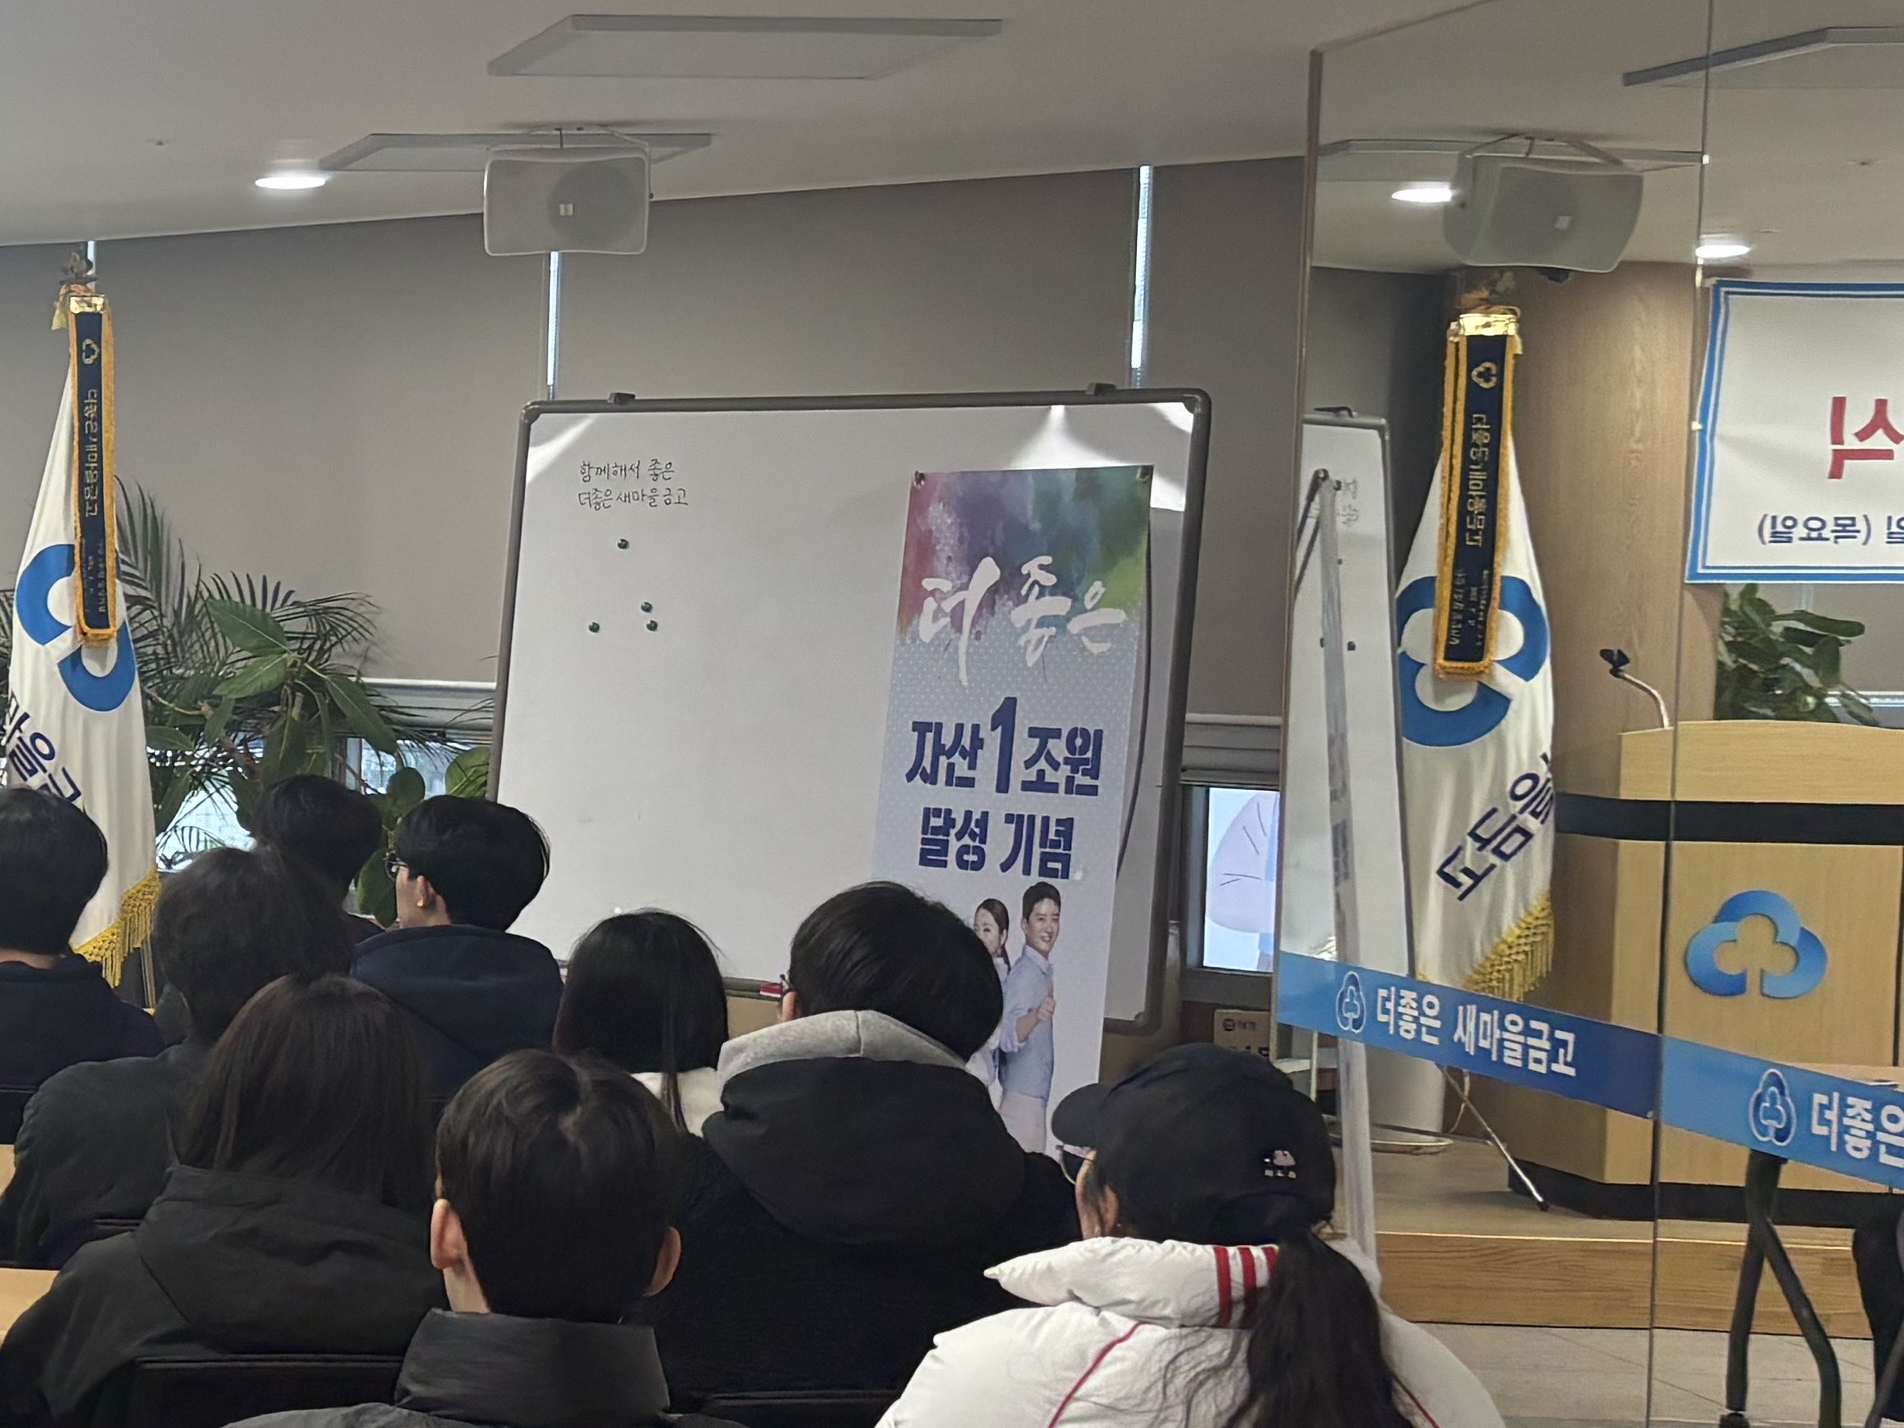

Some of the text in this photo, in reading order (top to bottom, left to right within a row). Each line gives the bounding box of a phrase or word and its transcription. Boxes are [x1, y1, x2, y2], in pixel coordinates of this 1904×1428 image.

[580, 458, 675, 483] 함께해서 좋은
[918, 807, 1075, 880] 달성 기념
[1376, 986, 1577, 1077] 더좋은 새마을금고
[1811, 1091, 1904, 1168] 더좋은
